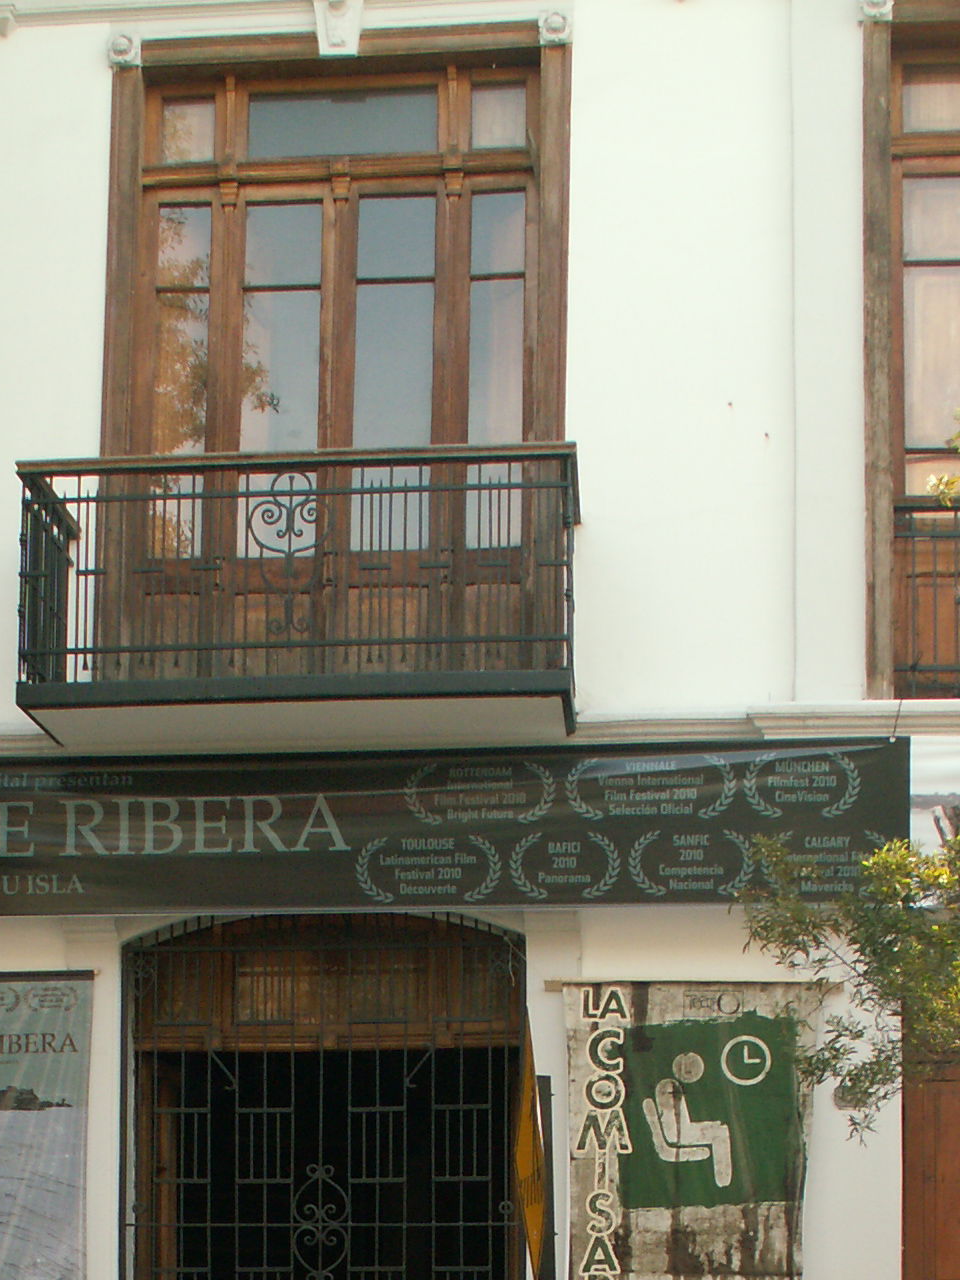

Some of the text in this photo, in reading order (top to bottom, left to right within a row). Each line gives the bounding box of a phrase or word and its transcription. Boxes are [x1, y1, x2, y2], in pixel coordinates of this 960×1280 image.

[625, 760, 677, 772] VIENNALE
[34, 773, 134, 792] presentan
[598, 774, 704, 787] Vienna International
[767, 775, 838, 788] Filmfest 2010
[604, 788, 698, 801] Film Festival 2010
[447, 808, 515, 822] Bright Future
[659, 803, 694, 815] Oficial
[58, 795, 352, 857] RIBERA
[401, 838, 455, 850] TOULOUSE
[672, 834, 710, 847] SANFIC
[804, 836, 851, 849] CALGARY
[547, 841, 581, 854] BAFICI
[379, 853, 477, 866] Latinamerican Film
[679, 849, 704, 861] 2010
[551, 857, 577, 869] 2010
[395, 867, 462, 881] Festival 2010
[538, 871, 591, 884] Panorama
[658, 864, 725, 878] Competencia
[26, 873, 85, 896] ISLA
[669, 879, 714, 891] Nacional
[581, 986, 630, 1021] LA
